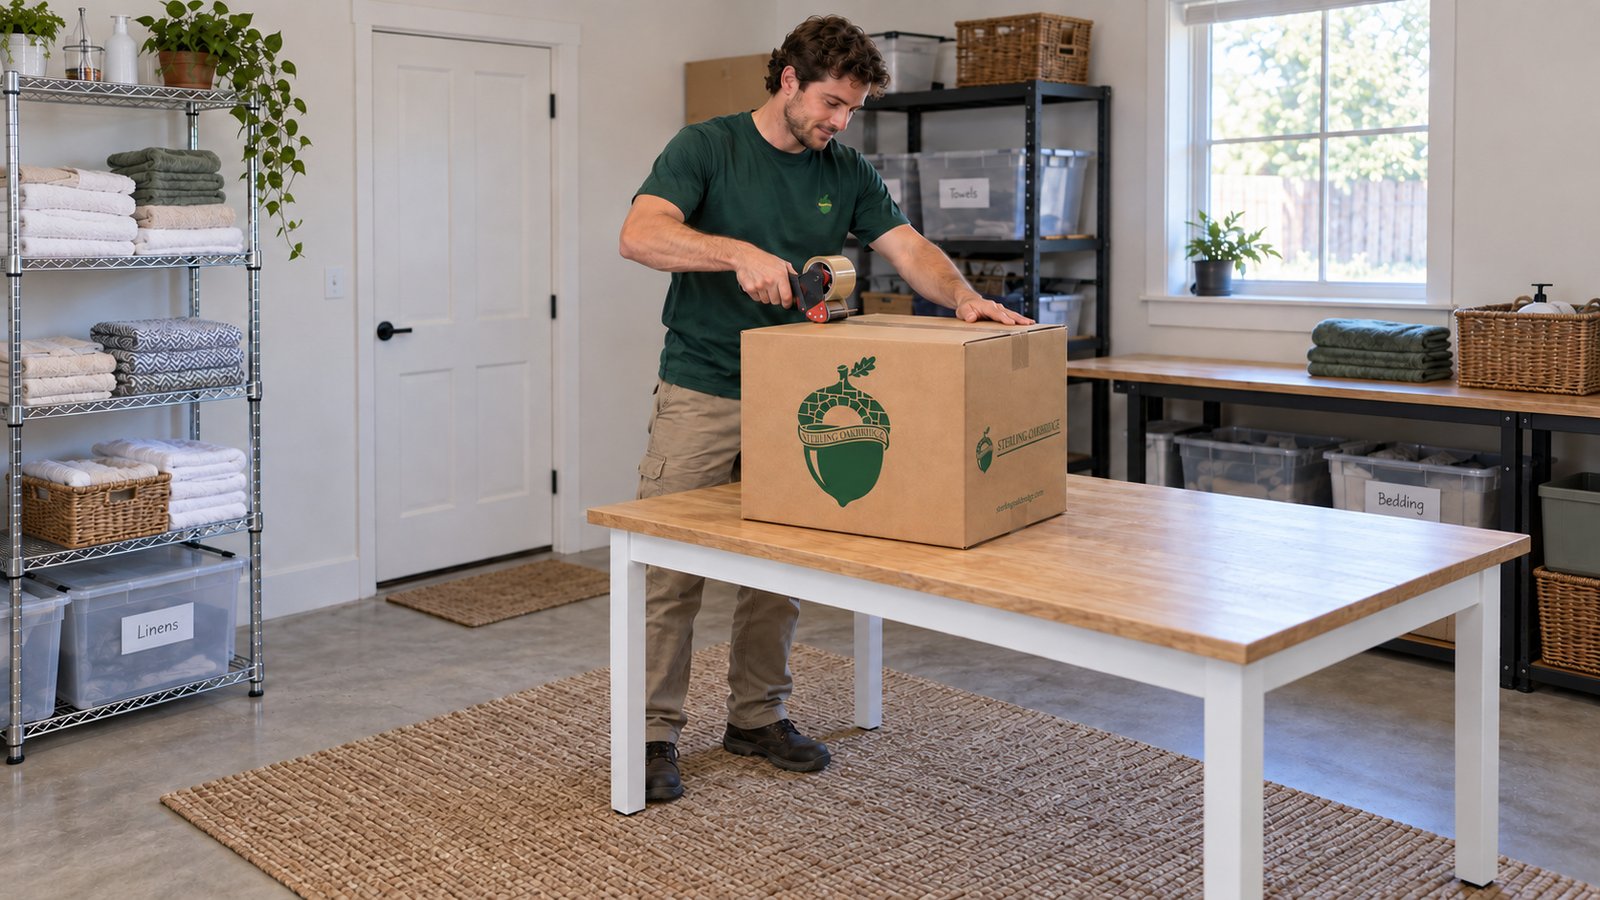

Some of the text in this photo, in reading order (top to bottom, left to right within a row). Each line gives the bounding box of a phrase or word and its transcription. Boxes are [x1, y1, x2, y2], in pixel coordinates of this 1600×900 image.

[949, 186, 978, 199] Towels
[997, 431, 1027, 451] STERLING
[1378, 491, 1424, 515] Bedding
[137, 621, 179, 639] Linens
